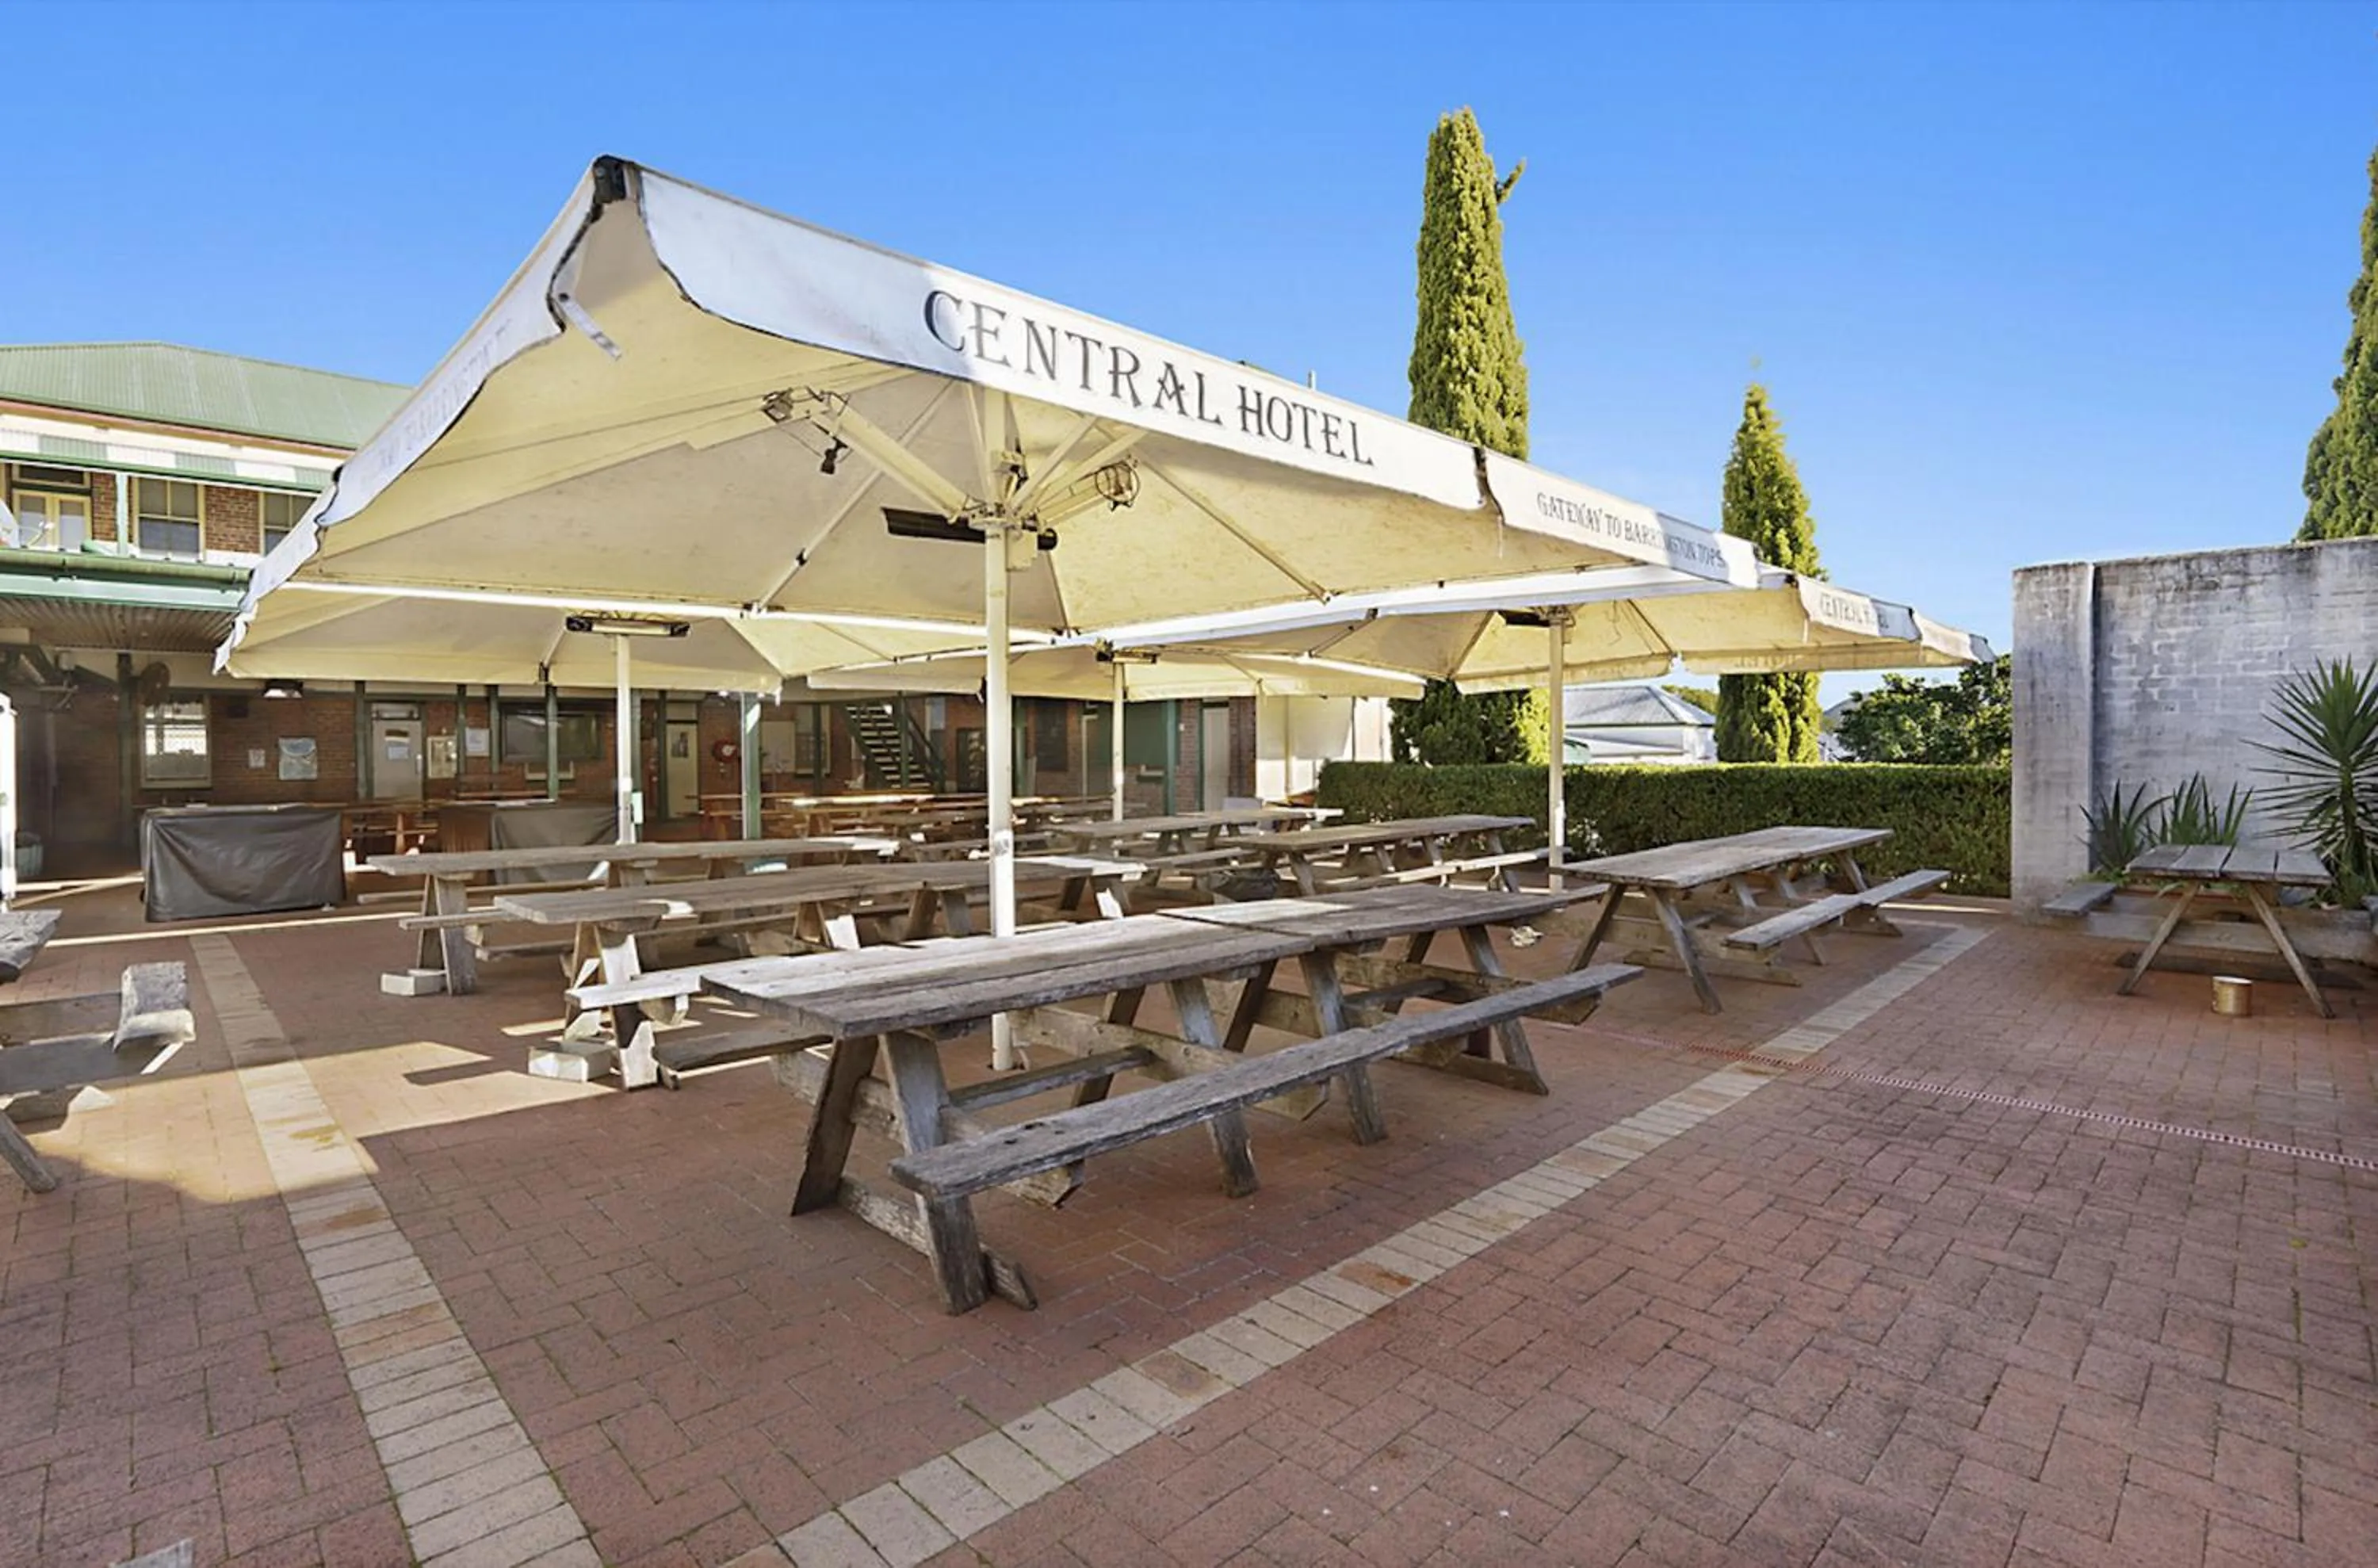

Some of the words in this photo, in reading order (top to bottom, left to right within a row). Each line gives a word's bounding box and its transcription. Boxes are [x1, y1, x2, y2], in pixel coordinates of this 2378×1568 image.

[923, 289, 1222, 426] CENTRAL
[1237, 384, 1374, 466] HOTEL
[1536, 491, 1602, 534] GATEWAY
[1604, 512, 1620, 539] TO
